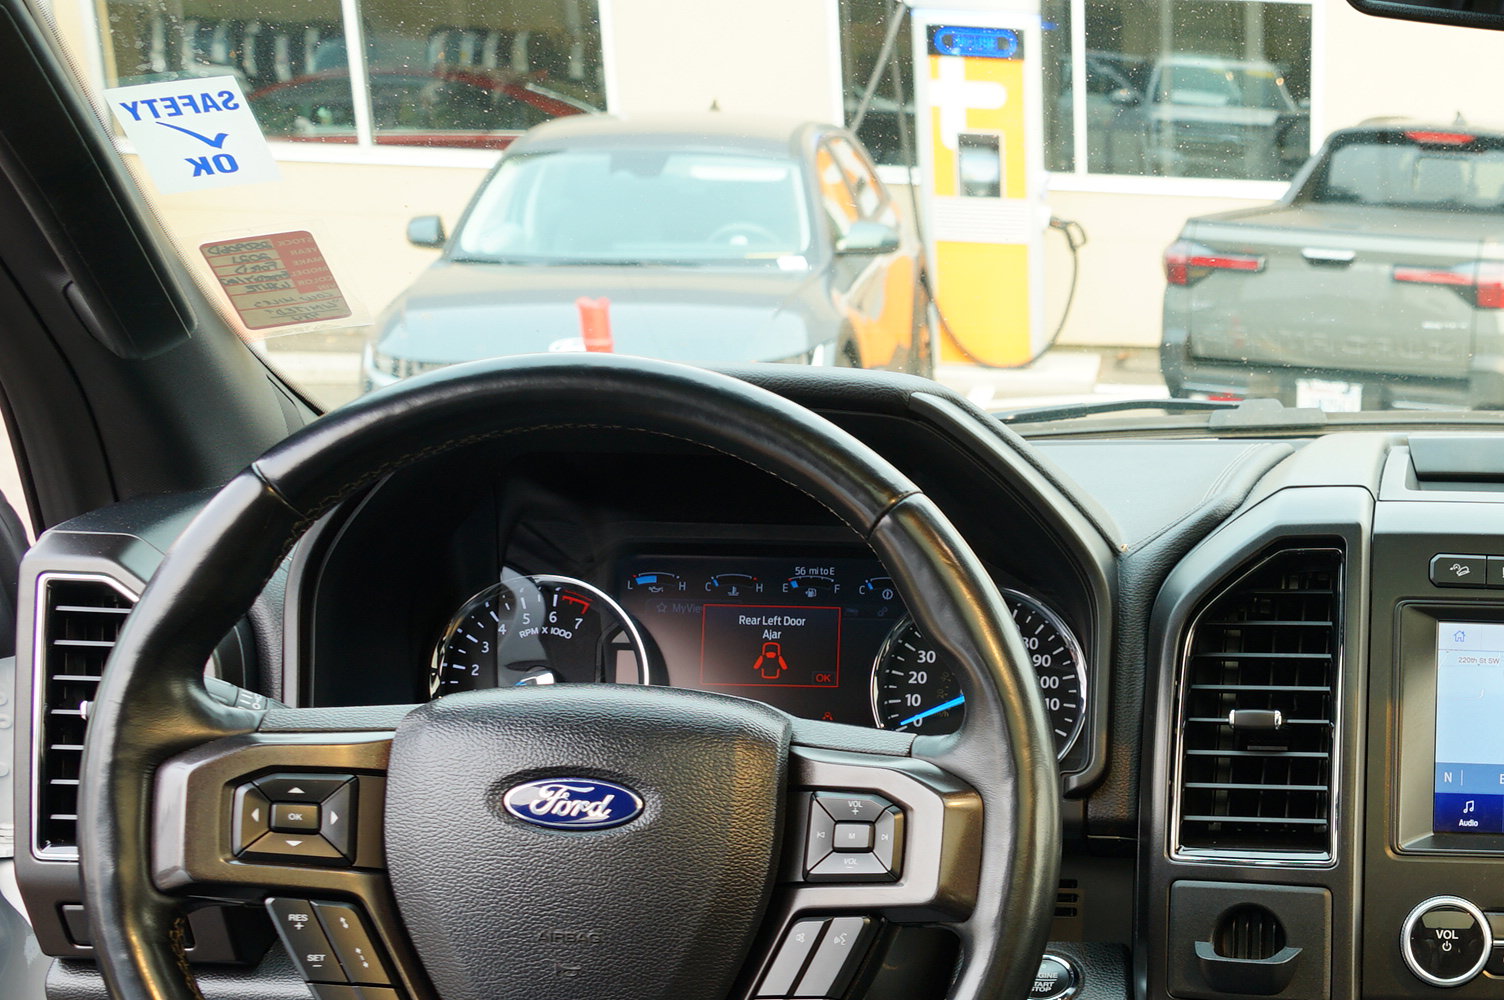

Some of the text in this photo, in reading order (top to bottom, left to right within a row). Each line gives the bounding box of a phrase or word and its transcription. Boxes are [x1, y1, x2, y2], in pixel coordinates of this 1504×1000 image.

[794, 566, 806, 576] 56
[808, 566, 820, 576] mi
[829, 567, 836, 576] E
[627, 580, 634, 590] L
[678, 582, 687, 592] H
[704, 582, 712, 592] C
[755, 583, 764, 593] H
[782, 583, 789, 593] E
[834, 584, 840, 594] F
[858, 585, 866, 595] C
[522, 613, 531, 625] 5
[549, 611, 558, 624] 6
[738, 615, 806, 627] Rear Left Door
[574, 617, 584, 630] 7
[497, 624, 507, 635] 4
[518, 626, 573, 640] RPM X 1000
[762, 628, 783, 641] Ajar
[481, 641, 490, 654] 3
[916, 649, 937, 664] 30
[1032, 654, 1052, 668] 90
[471, 664, 480, 677] 2
[815, 673, 832, 683] OK
[907, 670, 928, 685] 20
[904, 693, 922, 708] 10
[1443, 771, 1453, 783] N
[529, 783, 616, 823] Ford
[847, 799, 863, 809] VOL
[287, 812, 303, 822] OK
[1458, 818, 1479, 829] Audio
[848, 832, 856, 840] M
[843, 857, 859, 866] VOL
[287, 913, 309, 923] RES
[1434, 928, 1459, 941] VOL
[306, 953, 326, 963] SET
